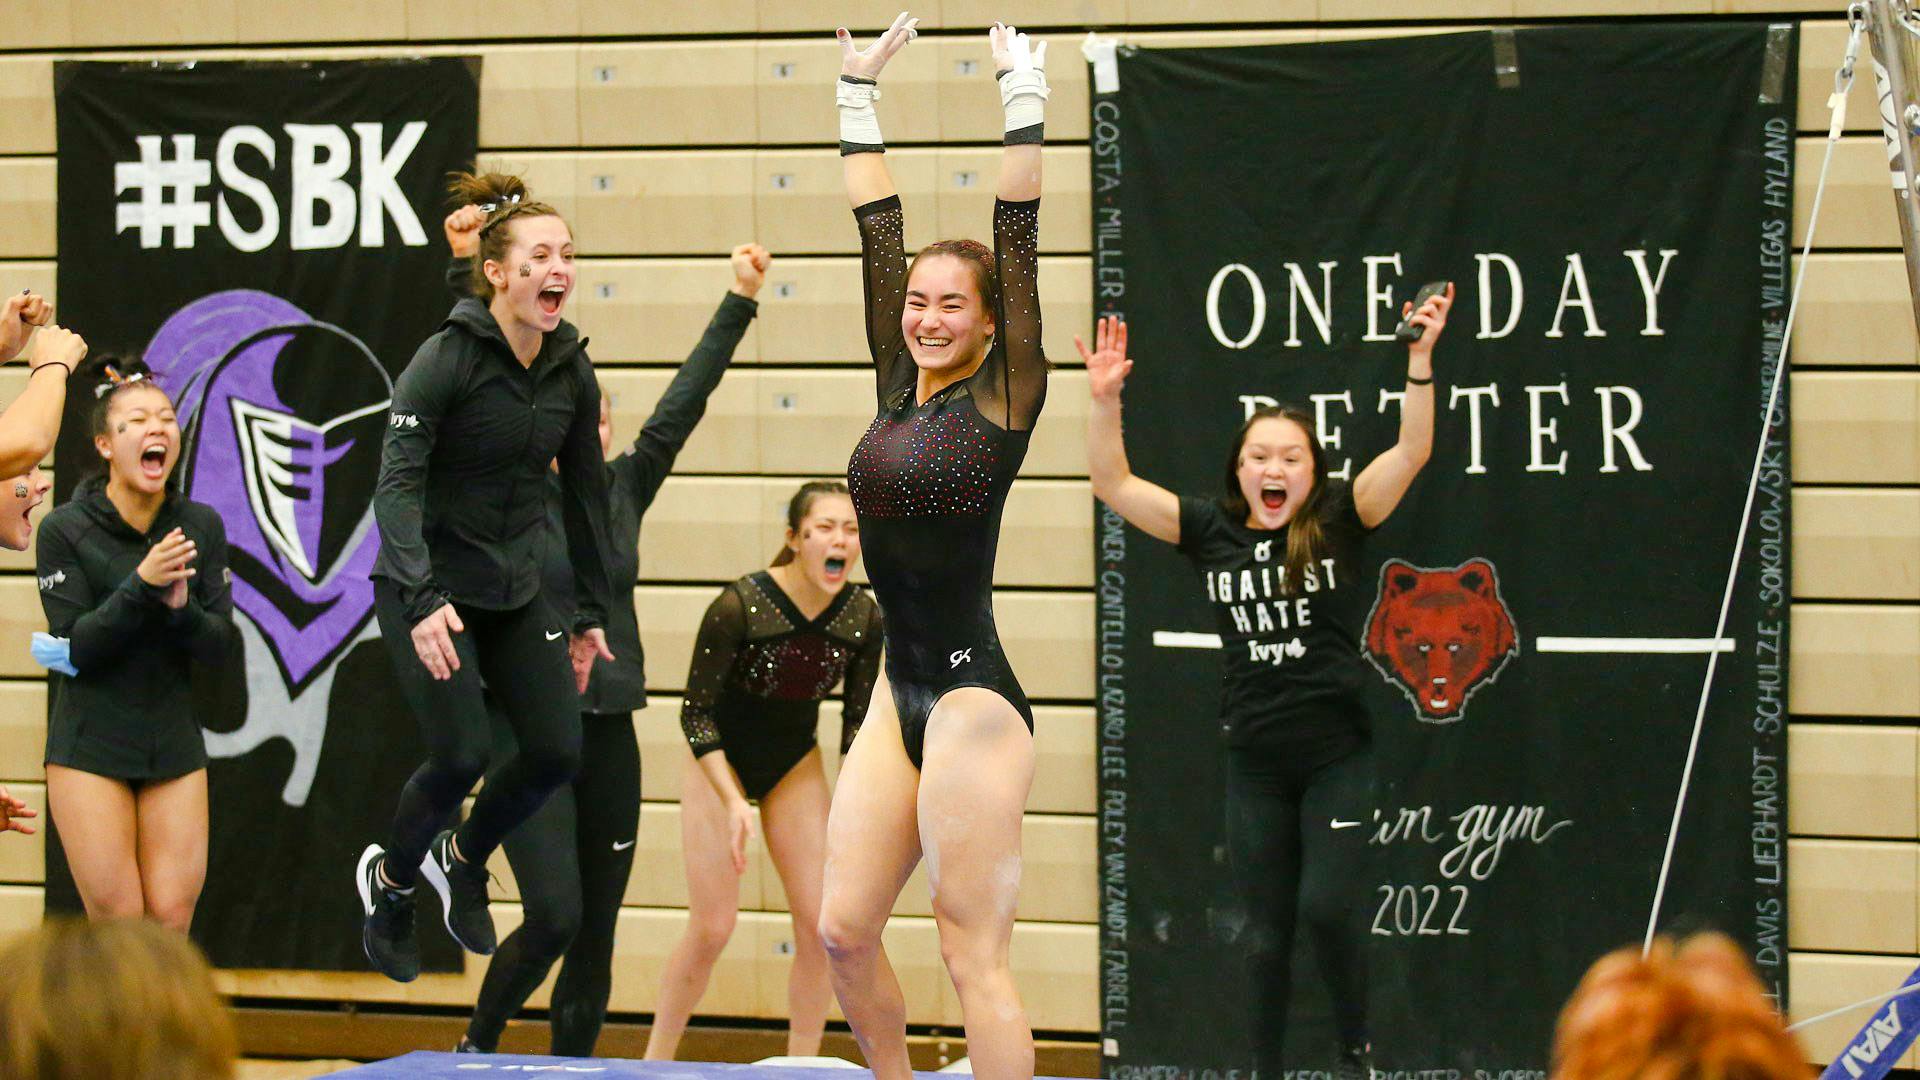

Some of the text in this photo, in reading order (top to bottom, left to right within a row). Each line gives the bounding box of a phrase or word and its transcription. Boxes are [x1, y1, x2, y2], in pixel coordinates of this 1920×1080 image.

[115, 121, 428, 252] #SBK
[1095, 101, 1121, 192] COSTA
[1763, 117, 1788, 208] HYLAND
[1098, 207, 1124, 296] MILLER
[1760, 219, 1785, 308] VILLEGAS
[1206, 249, 1678, 349] ONE DAY
[1758, 439, 1783, 608] SOKOLOWSKY
[1230, 598, 1312, 633] HATE
[1248, 640, 1285, 666] Ivy
[1103, 674, 1125, 739] LAZARO
[1754, 621, 1782, 734] SCHULZE
[1103, 746, 1126, 778] LEE
[1439, 804, 1575, 880] gym
[1752, 746, 1781, 884] LIEBHARDT
[1371, 885, 1471, 936] 2022
[1756, 898, 1781, 966] DAVIS
[1105, 950, 1128, 1032] FARRELL
